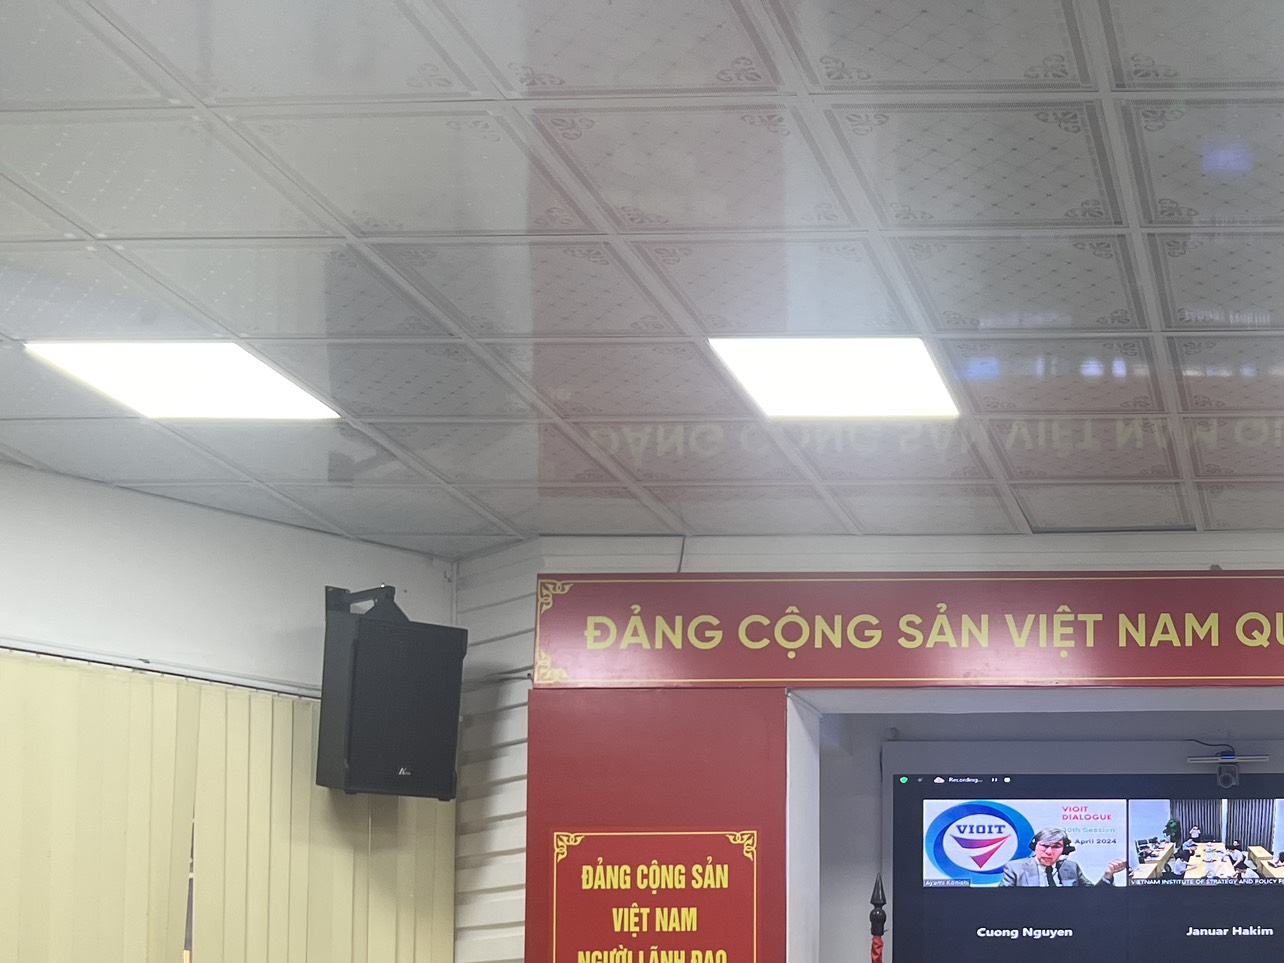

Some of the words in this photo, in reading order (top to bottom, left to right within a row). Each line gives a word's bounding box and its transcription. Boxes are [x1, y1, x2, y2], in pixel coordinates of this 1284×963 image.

[584, 605, 724, 651] ĐẢNG
[737, 606, 883, 660] CỘNG
[896, 604, 989, 650] SẢN
[1006, 605, 1104, 658] VIỆT
[1118, 612, 1220, 649] NAM
[956, 824, 1005, 834] VIOIT
[1074, 838, 1095, 846] April
[581, 857, 631, 890] ĐẢNG
[636, 860, 686, 895] CỘNG
[691, 857, 729, 889] SẢN
[612, 903, 651, 938] VIỆT
[655, 908, 698, 932] NAM
[976, 927, 1019, 939] Cuong
[1022, 927, 1073, 939] Nguyen
[1186, 926, 1229, 936] Januar
[1232, 925, 1274, 936] Hakim
